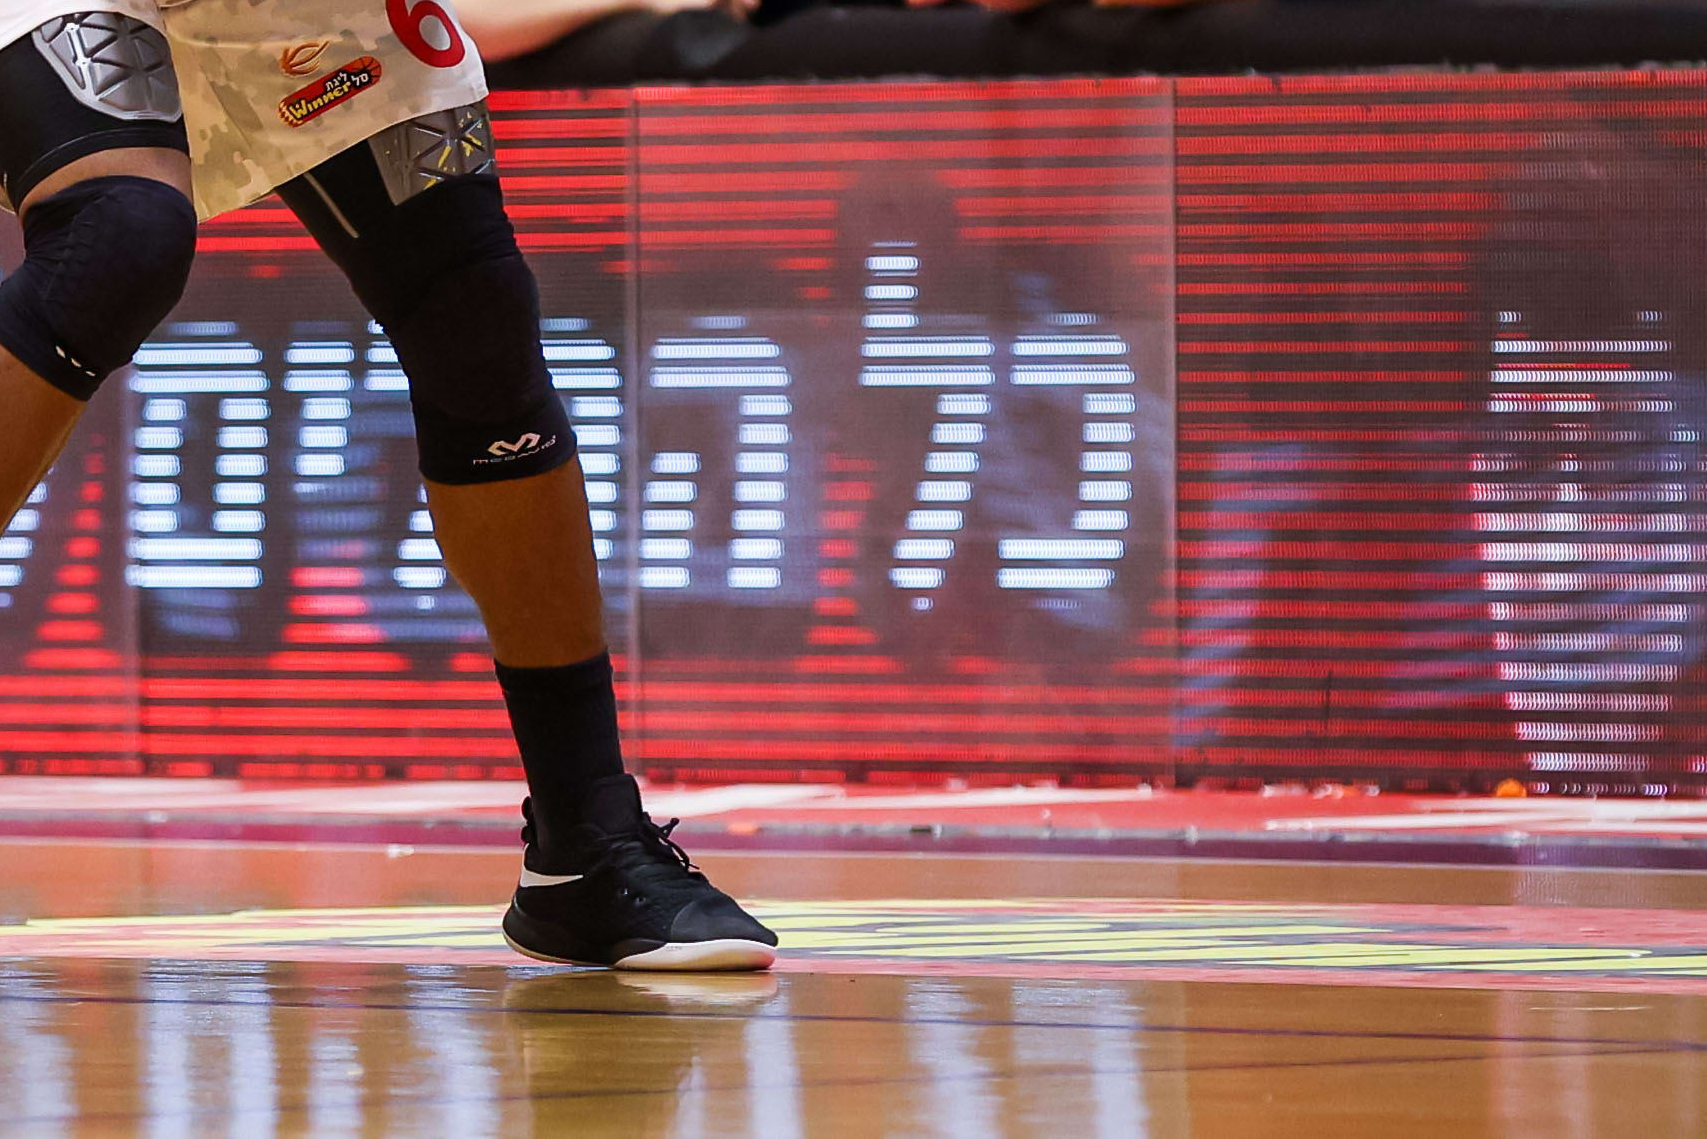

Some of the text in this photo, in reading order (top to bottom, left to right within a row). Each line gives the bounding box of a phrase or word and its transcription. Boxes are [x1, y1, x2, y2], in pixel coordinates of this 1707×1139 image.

[325, 71, 370, 92] ליגת סל
[289, 82, 352, 119] Winner
[862, 242, 1137, 607] כל
